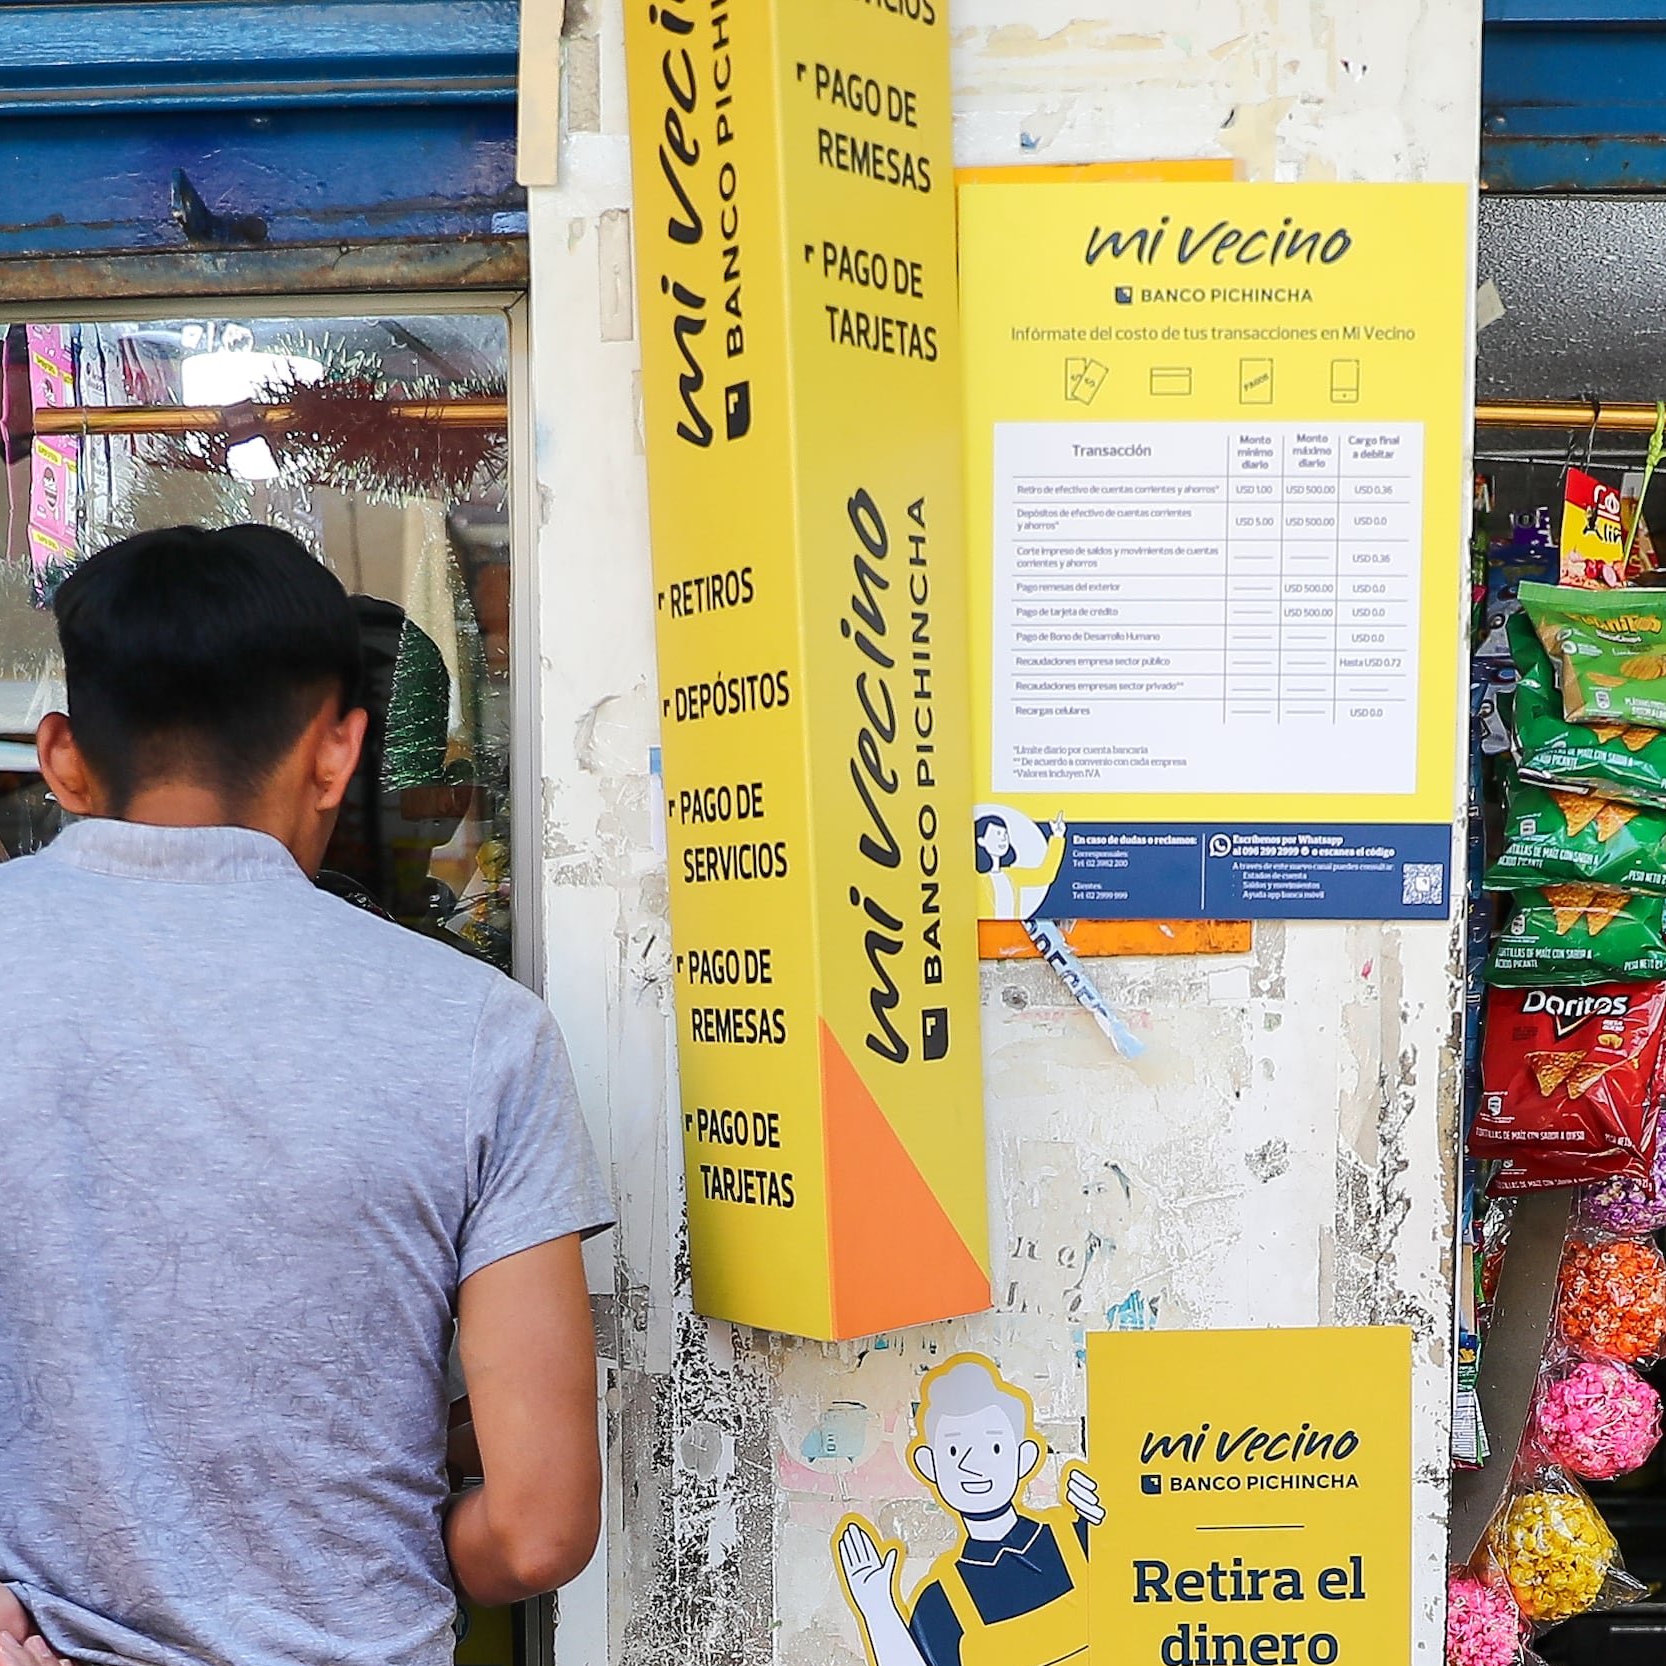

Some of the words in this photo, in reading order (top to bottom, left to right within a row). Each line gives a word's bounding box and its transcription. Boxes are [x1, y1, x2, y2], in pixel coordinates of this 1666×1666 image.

[815, 61, 881, 118] PAGO
[886, 83, 918, 129] DE
[816, 127, 932, 195] REMESAS
[717, 161, 747, 359] BANCO
[1084, 214, 1171, 266] mi
[822, 241, 888, 293] PAGO
[893, 257, 924, 299] DE
[1141, 288, 1205, 304] BANCO
[1211, 288, 1313, 303] PICHINCHA
[825, 305, 939, 364] TARJETAS
[1011, 326, 1087, 342] Infórmate
[1089, 327, 1112, 341] del
[1115, 327, 1157, 341] costo
[1160, 327, 1180, 340] de
[1183, 327, 1208, 341] tus
[1211, 327, 1317, 342] transacciones
[1320, 329, 1340, 341] en
[1342, 327, 1362, 340] Mi
[1365, 327, 1415, 341] Vecino
[660, 274, 715, 448] mi
[1072, 443, 1152, 459] Transacción
[669, 566, 755, 620] RETIROS
[908, 495, 938, 792] PICHINCHA
[674, 669, 790, 723] DEPÓSITOS
[679, 782, 730, 825] PAGO
[734, 782, 765, 820] DE
[683, 841, 789, 885] SERVICIOS
[918, 804, 946, 988] BANCO
[687, 949, 738, 986] PAGO
[742, 948, 773, 985] DE
[849, 890, 912, 1066] mi
[691, 1008, 787, 1046] REMESAS
[1522, 990, 1629, 1017] Doritos
[697, 1111, 746, 1148] PAGO
[750, 1111, 781, 1148] DE
[699, 1164, 795, 1210] TARJETAS
[1141, 1422, 1209, 1466] mi
[1170, 1474, 1243, 1492] BANCO
[1247, 1472, 1359, 1491] PICHINCHA
[1132, 1558, 1305, 1604] Retira
[1317, 1554, 1367, 1601] el
